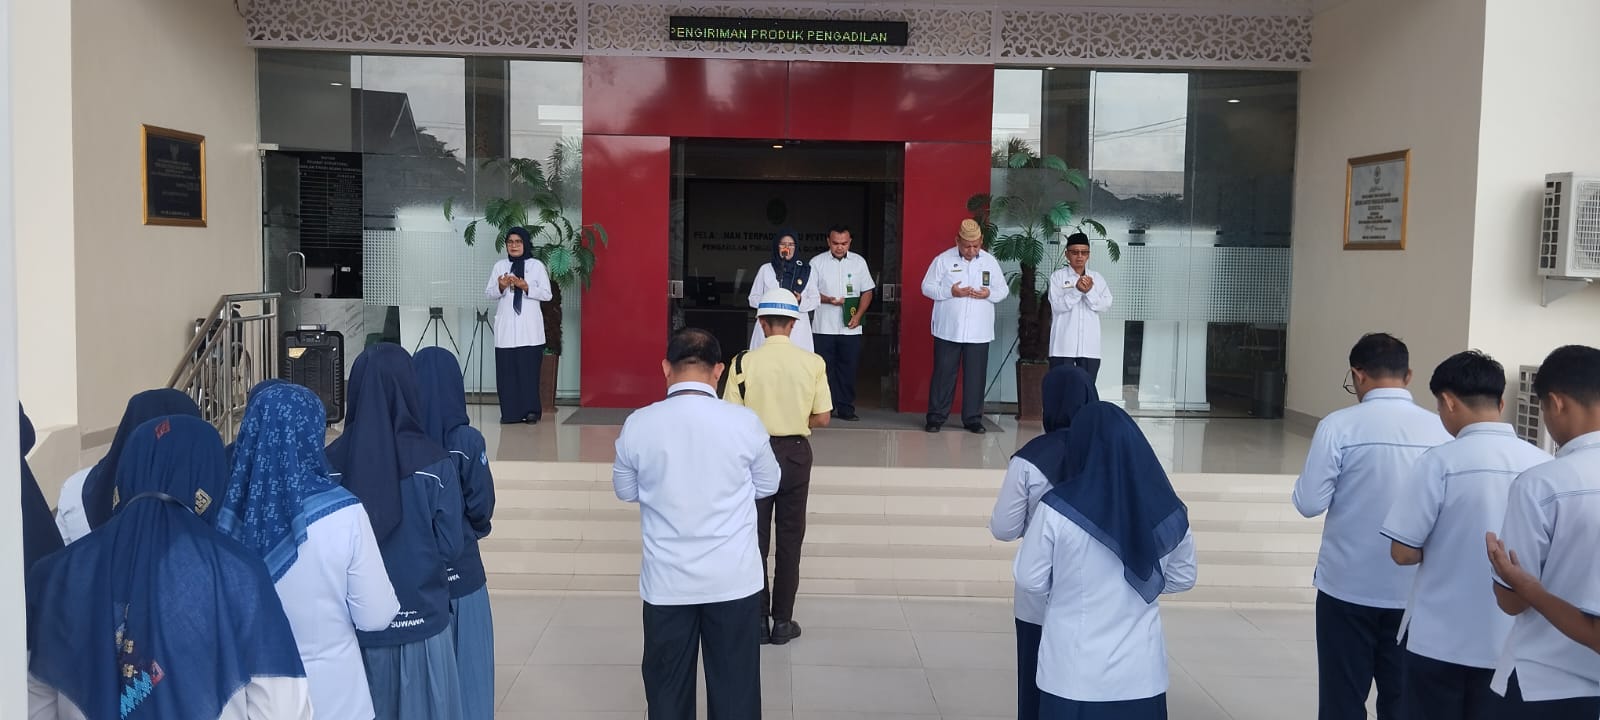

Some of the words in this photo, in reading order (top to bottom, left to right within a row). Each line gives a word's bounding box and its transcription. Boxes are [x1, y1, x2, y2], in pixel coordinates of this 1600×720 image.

[751, 29, 804, 40] PRODUK
[807, 30, 887, 42] PENGADILAN
[391, 618, 425, 628] SUWAWA
